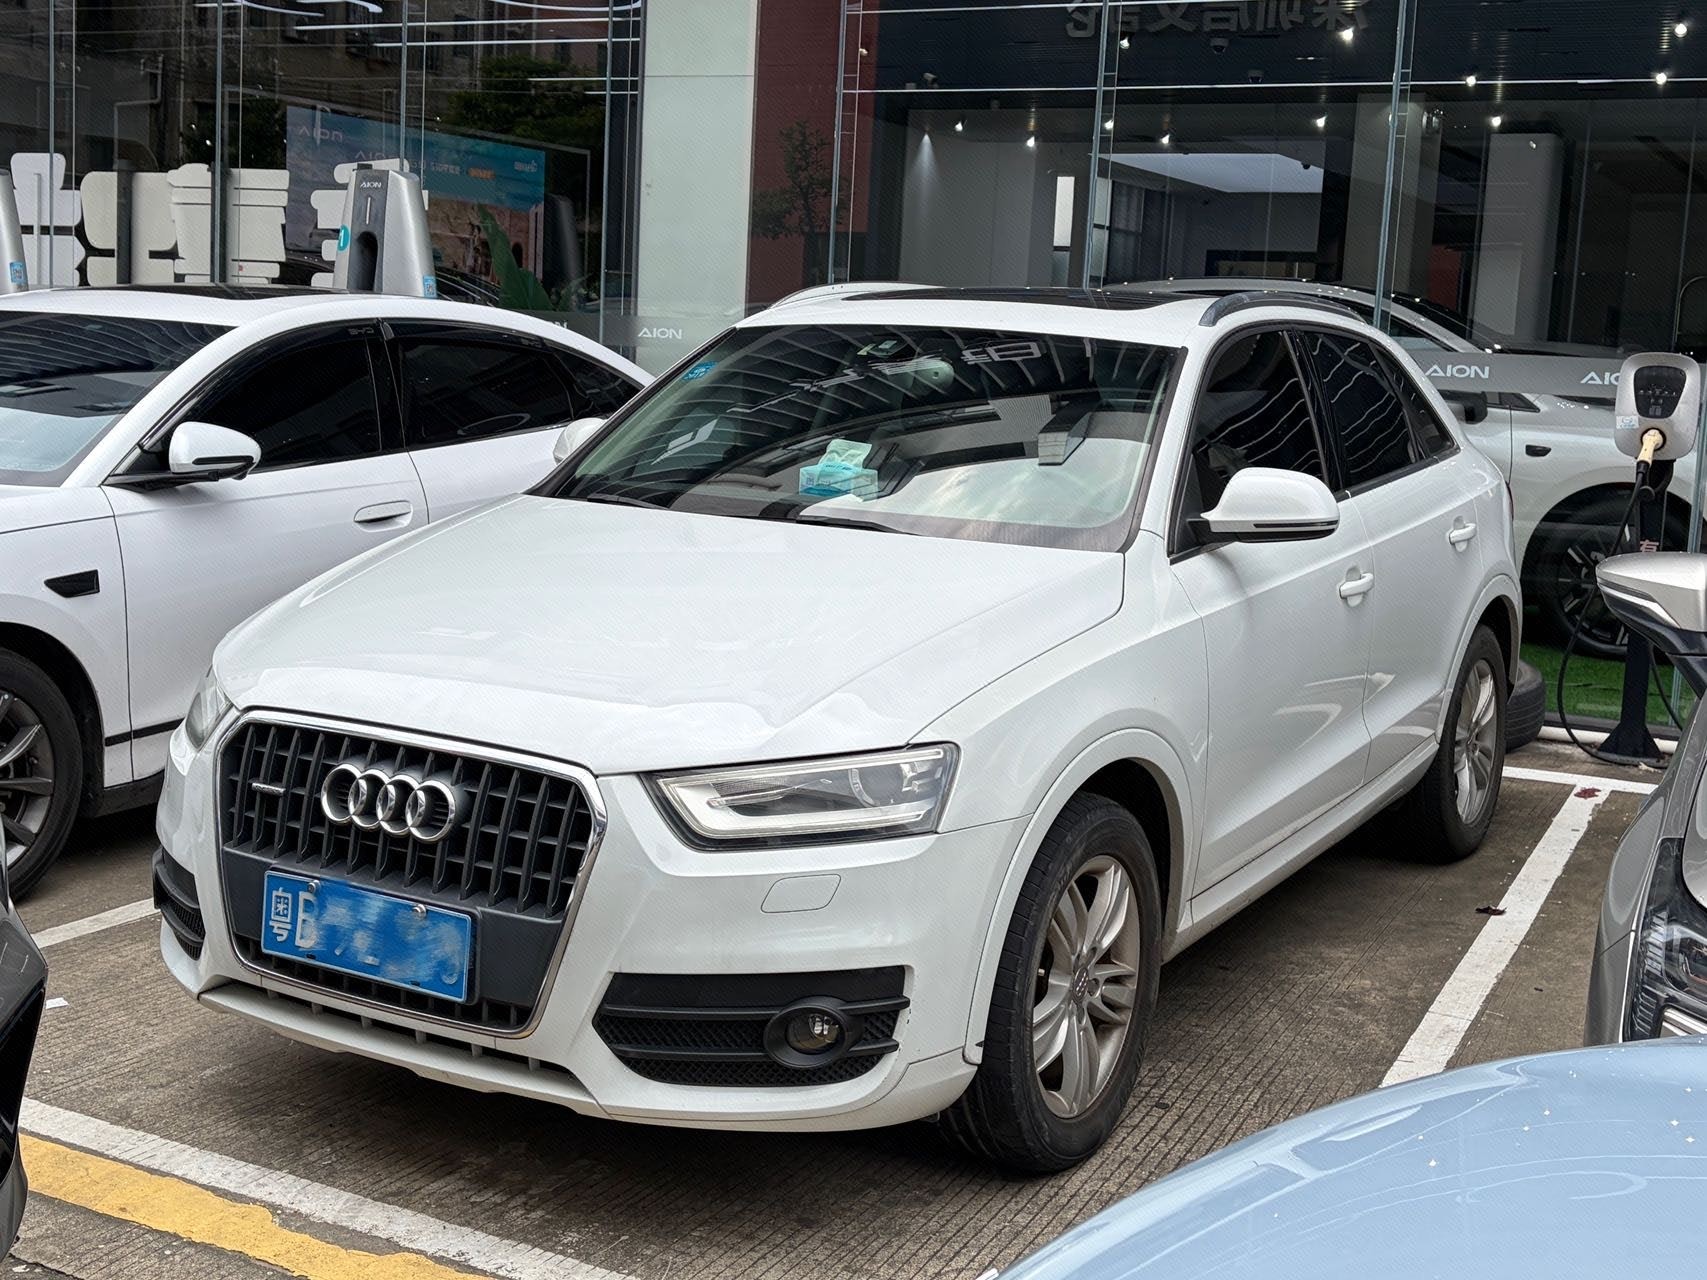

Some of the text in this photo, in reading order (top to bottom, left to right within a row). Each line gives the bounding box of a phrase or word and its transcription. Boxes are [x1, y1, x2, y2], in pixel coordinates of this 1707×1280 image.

[638, 327, 682, 339] AION
[1425, 364, 1489, 378] AION
[1580, 371, 1620, 385] AIO
